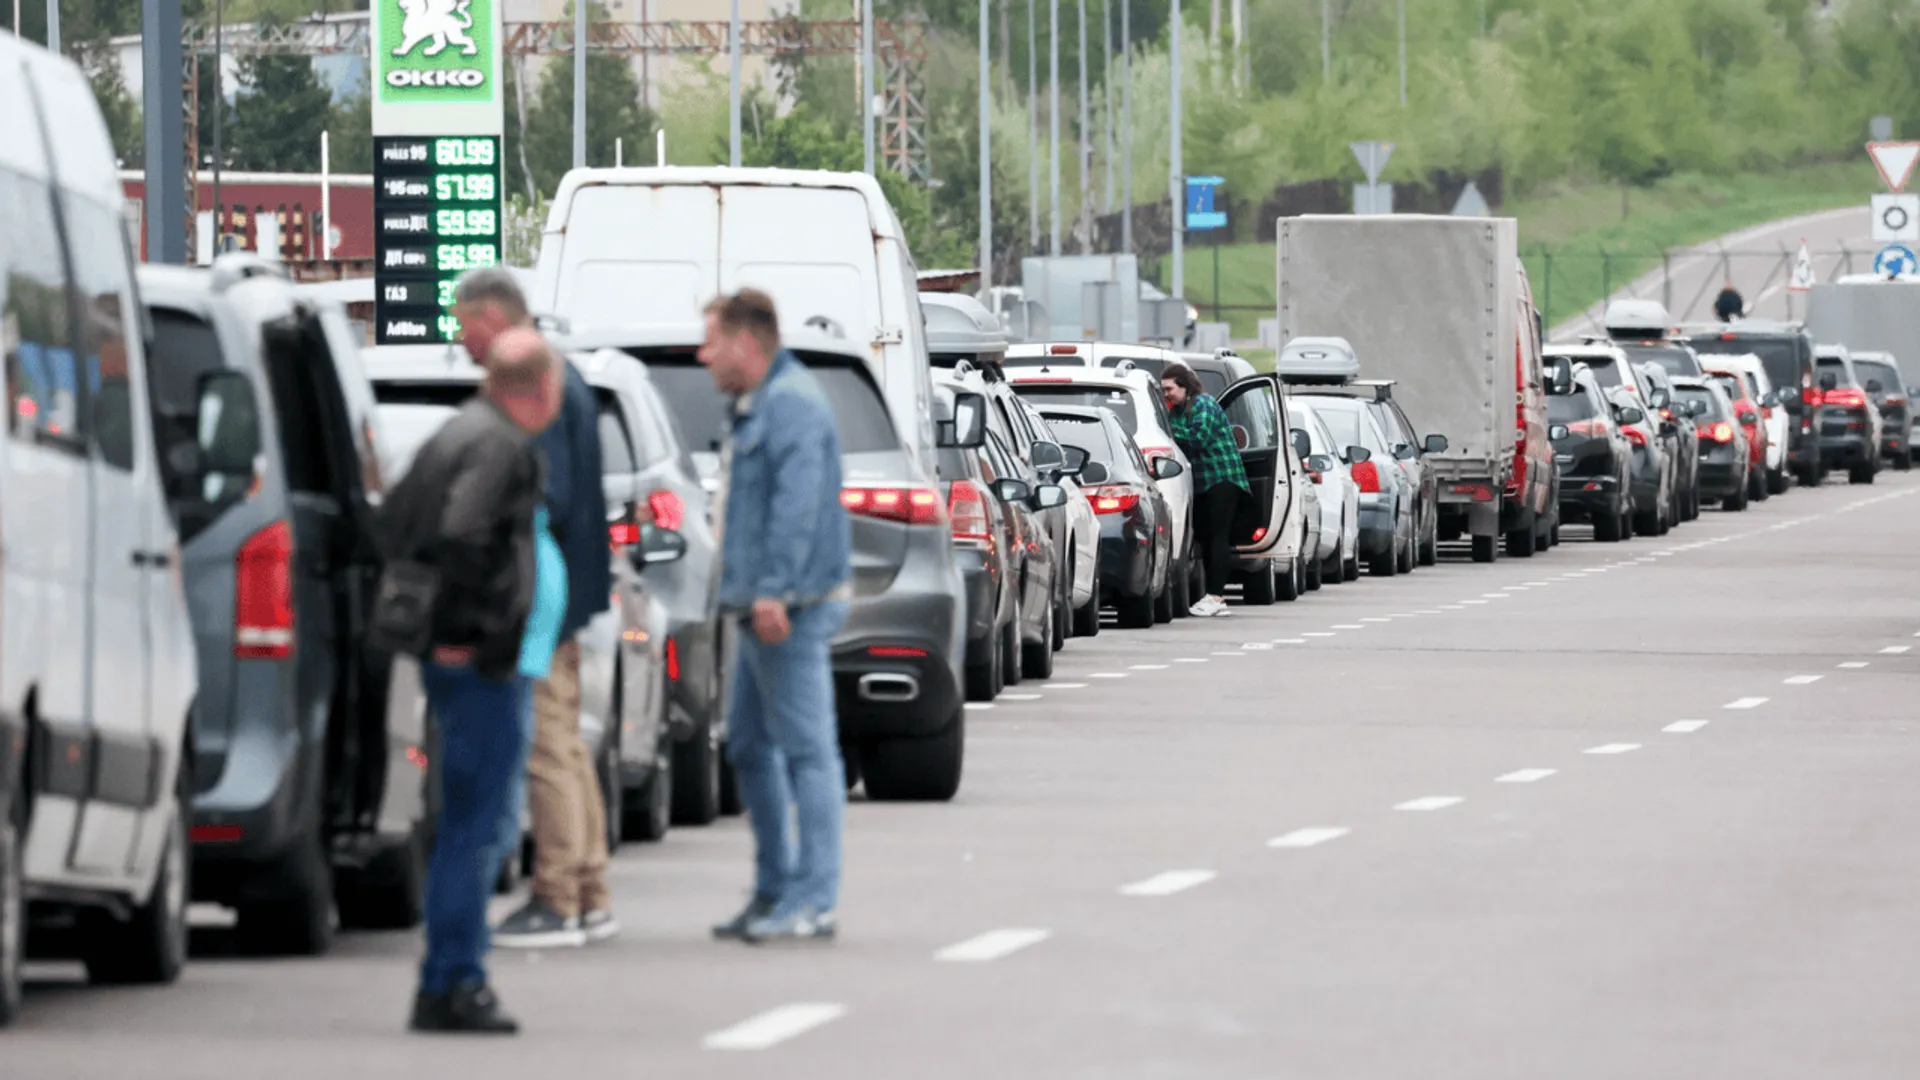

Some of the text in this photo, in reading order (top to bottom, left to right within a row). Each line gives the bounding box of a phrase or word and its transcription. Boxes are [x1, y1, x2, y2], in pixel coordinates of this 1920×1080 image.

[386, 69, 485, 88] OKKO
[410, 144, 428, 160] 95
[436, 138, 494, 166] 60.99
[436, 174, 494, 200] 57.99
[437, 210, 495, 235] 59.99
[437, 244, 496, 270] 56.99
[384, 285, 408, 301] ГАЗ
[386, 321, 427, 337] AdBlue
